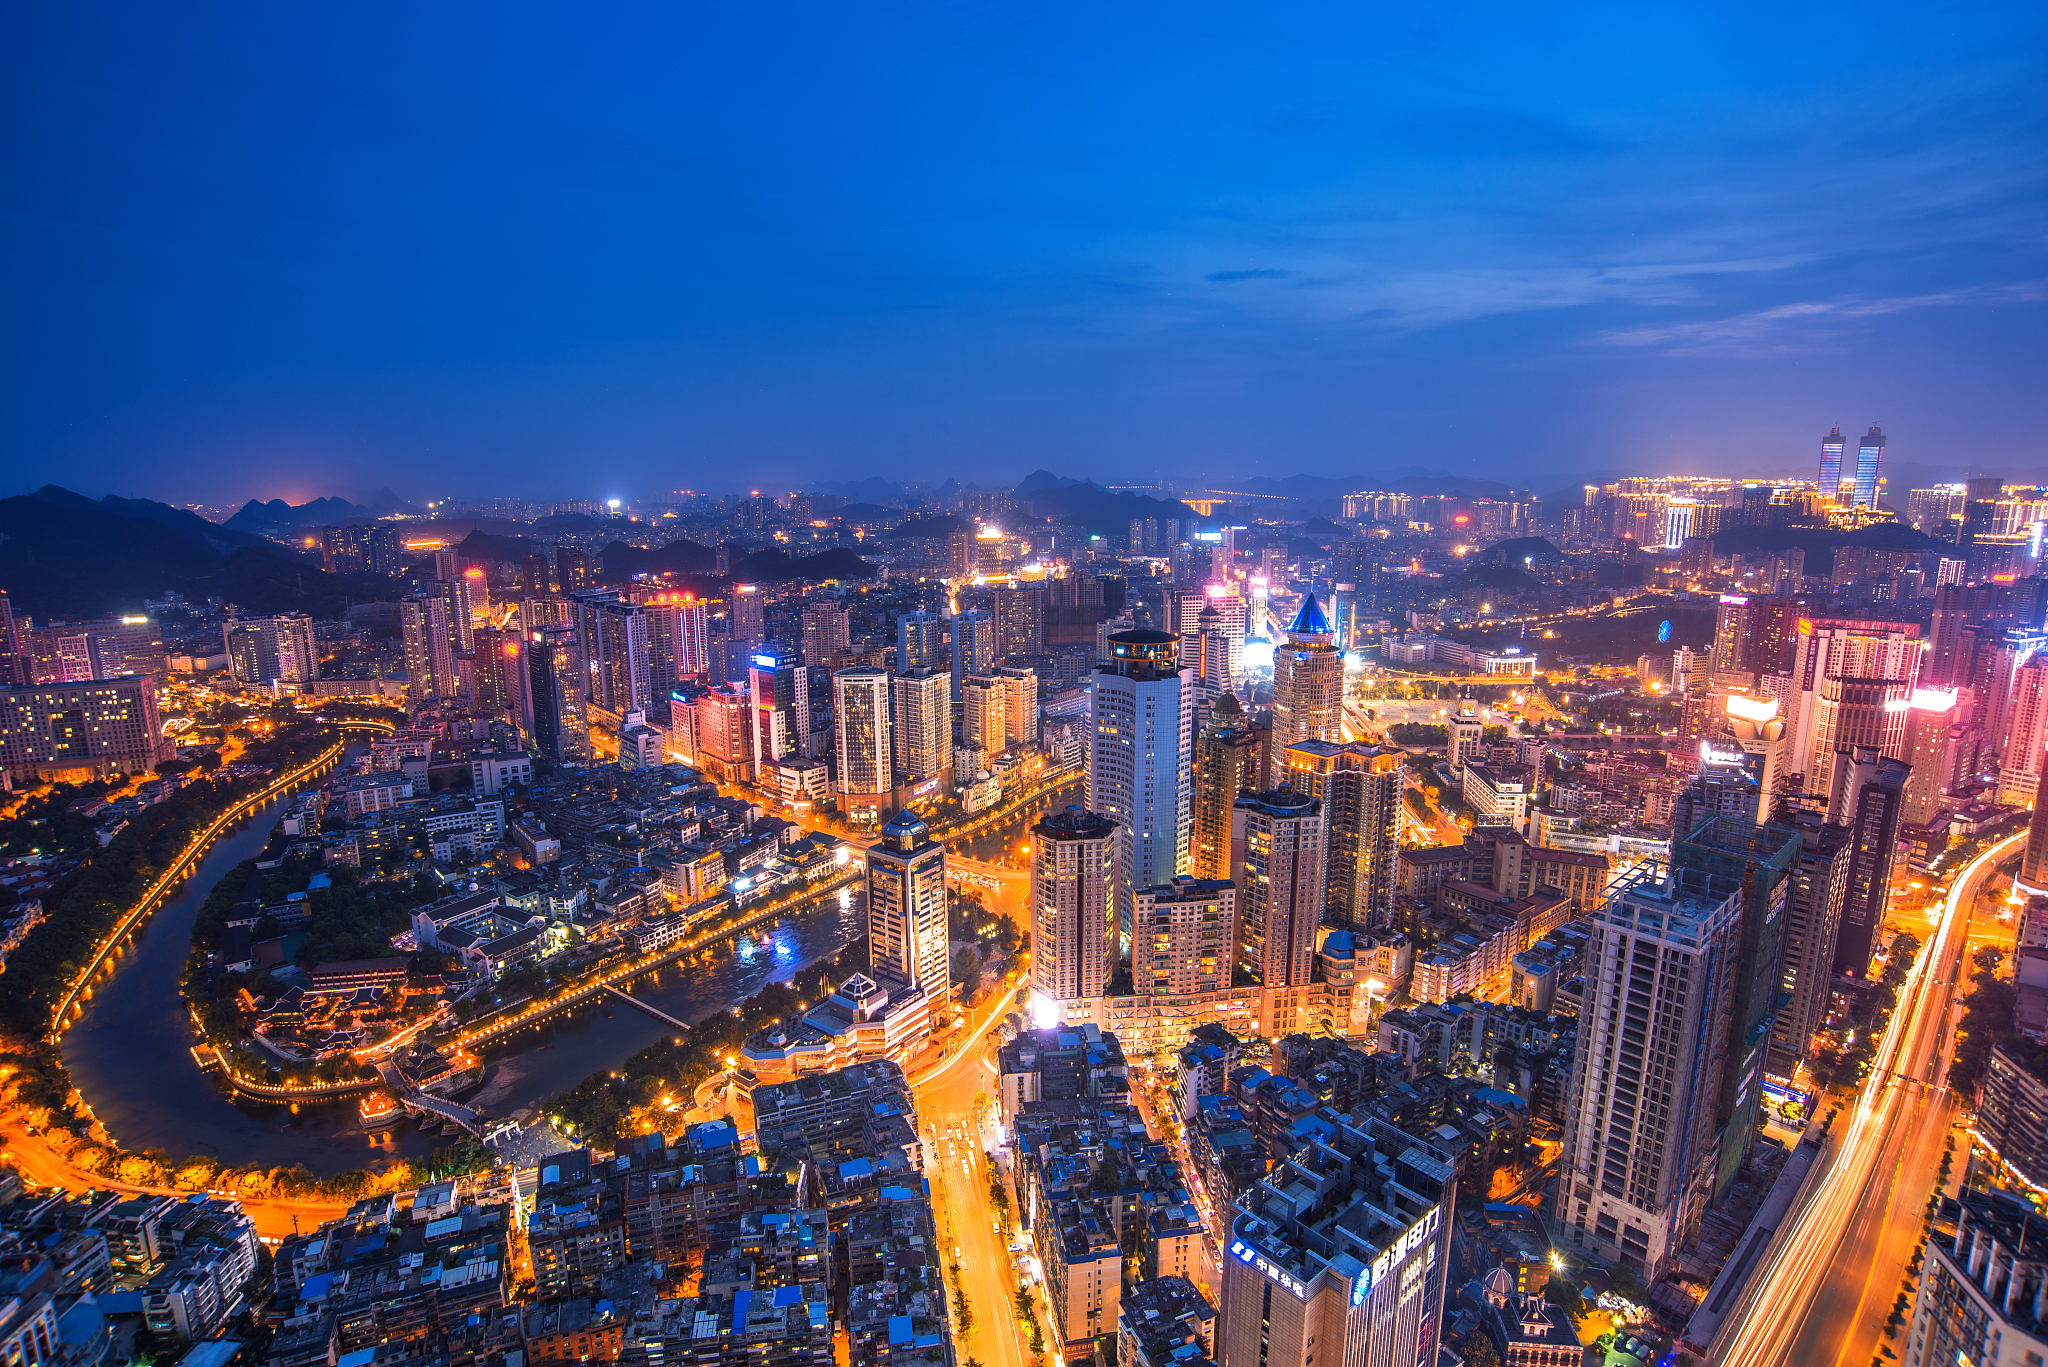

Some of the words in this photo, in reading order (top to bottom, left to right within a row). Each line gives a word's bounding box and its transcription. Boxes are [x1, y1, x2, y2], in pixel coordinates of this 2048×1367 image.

[1371, 1204, 1441, 1288] 黔源电力
[1256, 1258, 1305, 1299] 中国华电
